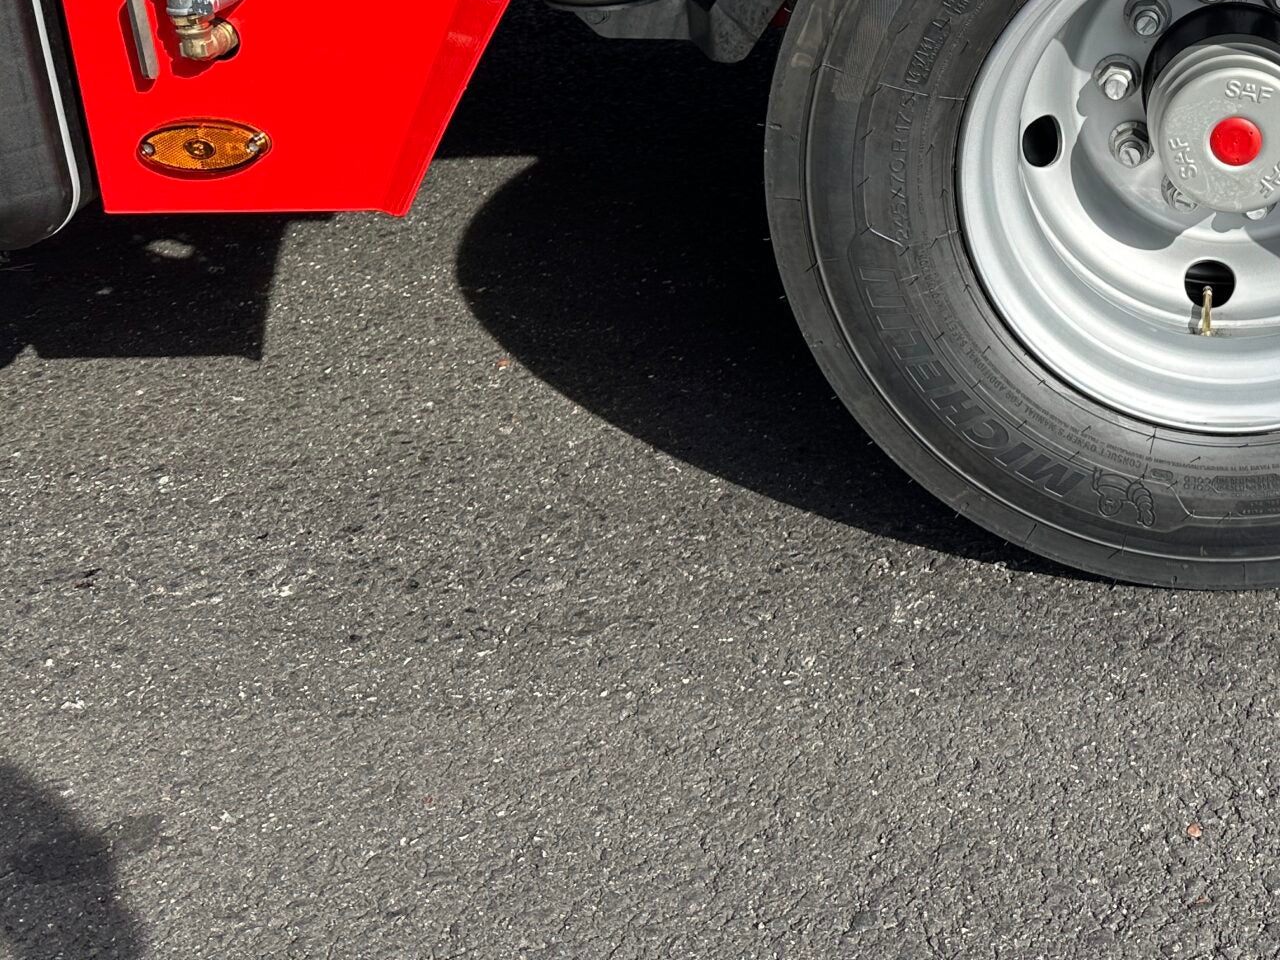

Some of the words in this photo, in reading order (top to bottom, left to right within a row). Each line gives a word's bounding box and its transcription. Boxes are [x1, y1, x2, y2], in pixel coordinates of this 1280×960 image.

[1225, 80, 1274, 104] SAF
[1168, 137, 1198, 180] SAF
[859, 265, 1084, 499] MICHELIN
[1003, 389, 1023, 408] FOR
